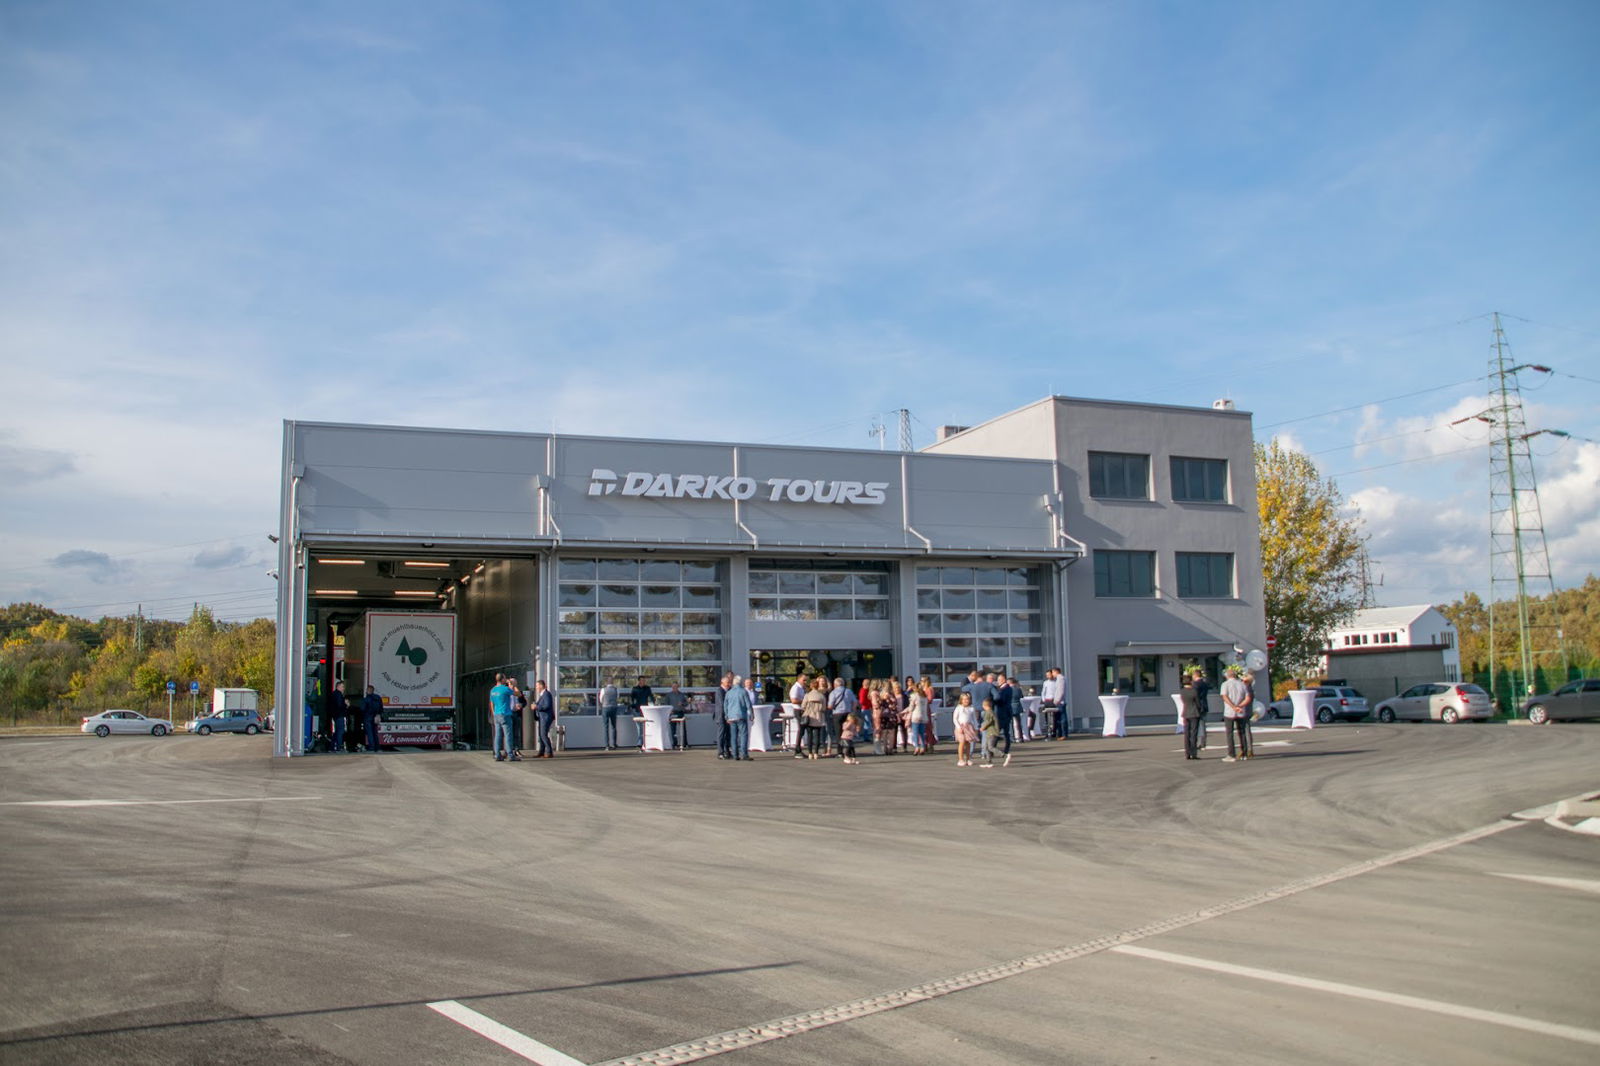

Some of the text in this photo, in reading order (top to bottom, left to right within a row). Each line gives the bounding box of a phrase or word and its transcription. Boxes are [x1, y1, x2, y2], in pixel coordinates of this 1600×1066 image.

[621, 471, 758, 501] DARKO
[768, 478, 890, 505] TOURS
[382, 733, 395, 743] No
